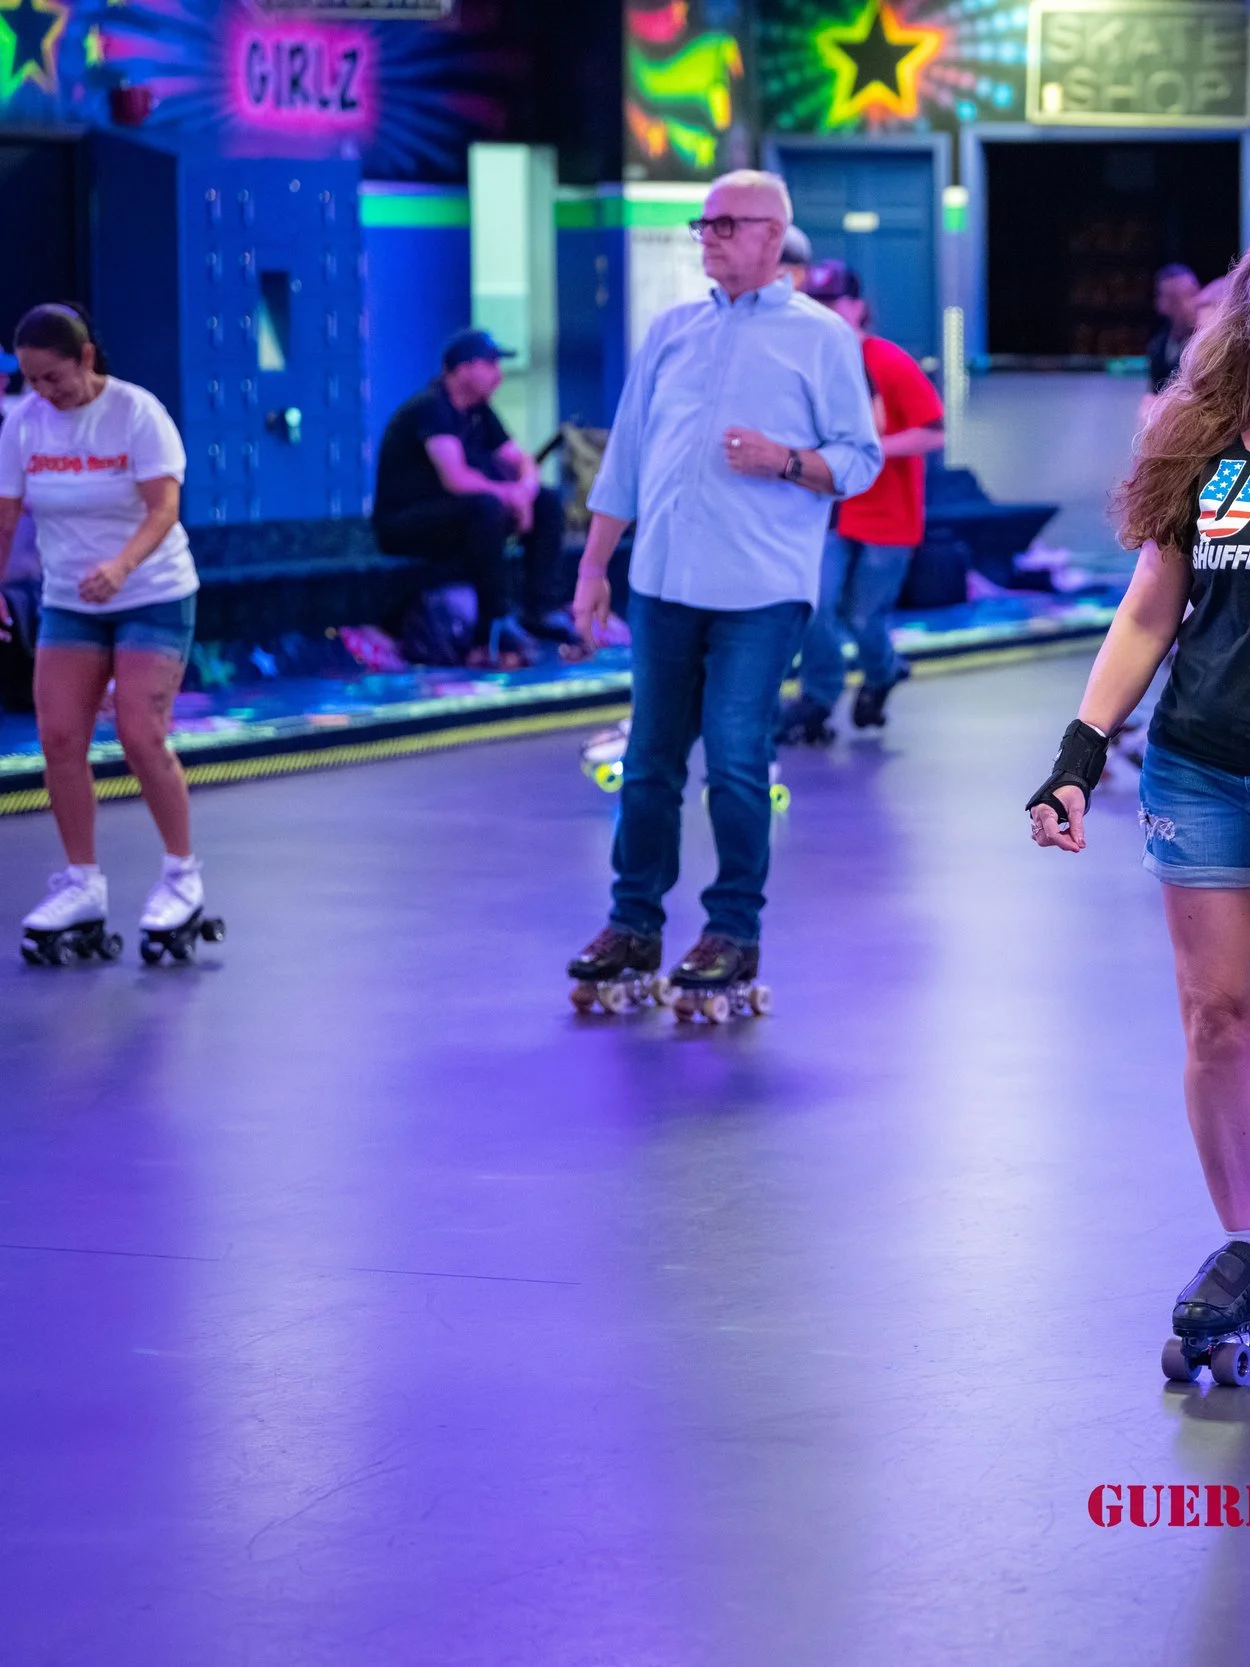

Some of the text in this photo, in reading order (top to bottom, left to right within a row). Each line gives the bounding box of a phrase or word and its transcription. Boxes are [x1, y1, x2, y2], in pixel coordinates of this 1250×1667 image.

[1047, 13, 1241, 65] SKATE
[246, 40, 361, 112] GIRLZ
[1062, 66, 1235, 113] SHOP
